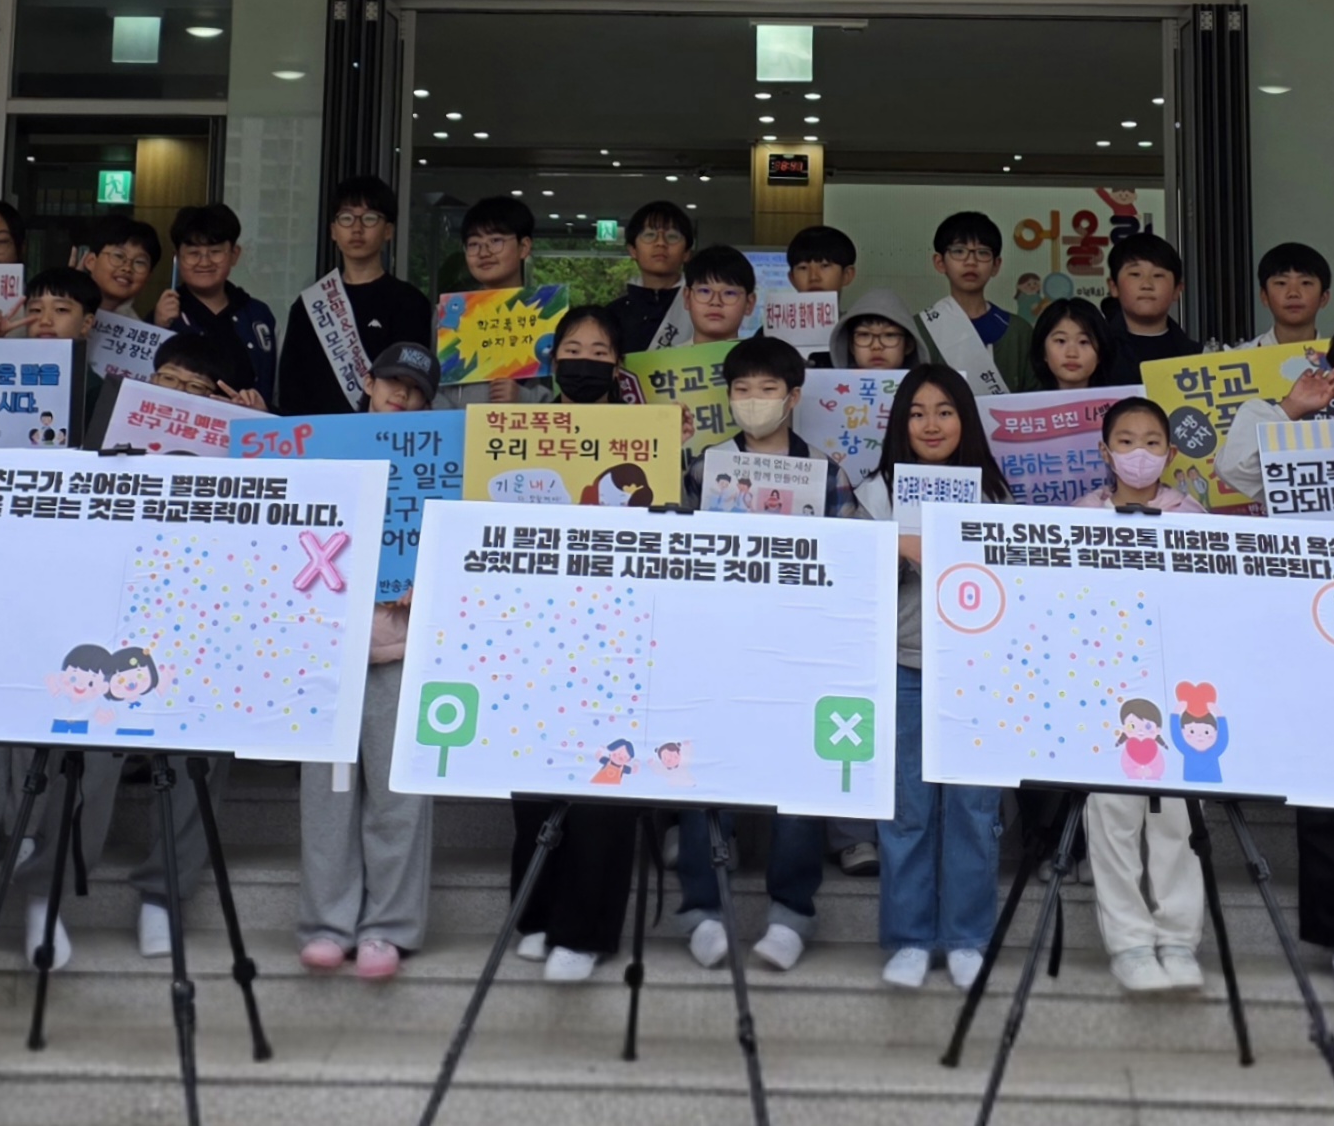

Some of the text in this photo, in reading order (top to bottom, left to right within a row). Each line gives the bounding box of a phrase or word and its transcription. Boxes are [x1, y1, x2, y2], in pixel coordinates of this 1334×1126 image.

[767, 303, 796, 329] 친구사랑
[311, 300, 334, 328] 우리
[325, 330, 348, 361] 모두
[101, 338, 126, 355] 그냥
[1173, 362, 1259, 407] 학교
[127, 411, 161, 430] 친구
[165, 422, 199, 441] 사랑
[140, 400, 190, 424] 바르고
[486, 411, 581, 434] 학교폭력,
[1005, 417, 1047, 433] 무심코
[1052, 411, 1079, 429] 던진
[241, 423, 313, 459] STOP
[486, 438, 527, 461] 우리
[536, 439, 599, 461] 모두의
[608, 439, 658, 462] 책임!
[413, 462, 463, 489] 일은
[733, 455, 750, 466] 학교
[795, 462, 812, 472] 세상
[69, 472, 163, 496] 싫어하는
[170, 475, 288, 500] 별명이라도
[10, 495, 82, 520] 부르는
[87, 497, 134, 521] 것은
[142, 499, 260, 525] 학교폭력이
[267, 503, 344, 527] 아니다.
[482, 526, 817, 560] 내 말과 행동으로 친구가 기분이
[1163, 528, 1229, 552] 대화방
[1235, 532, 1300, 557] 등에서
[464, 550, 834, 586] 상했다면 바로 사과하는 것이 좋다.
[984, 545, 1071, 568] 따돌림도
[1078, 548, 1164, 571] 학교폭력
[1171, 552, 1237, 576] 범죄에
